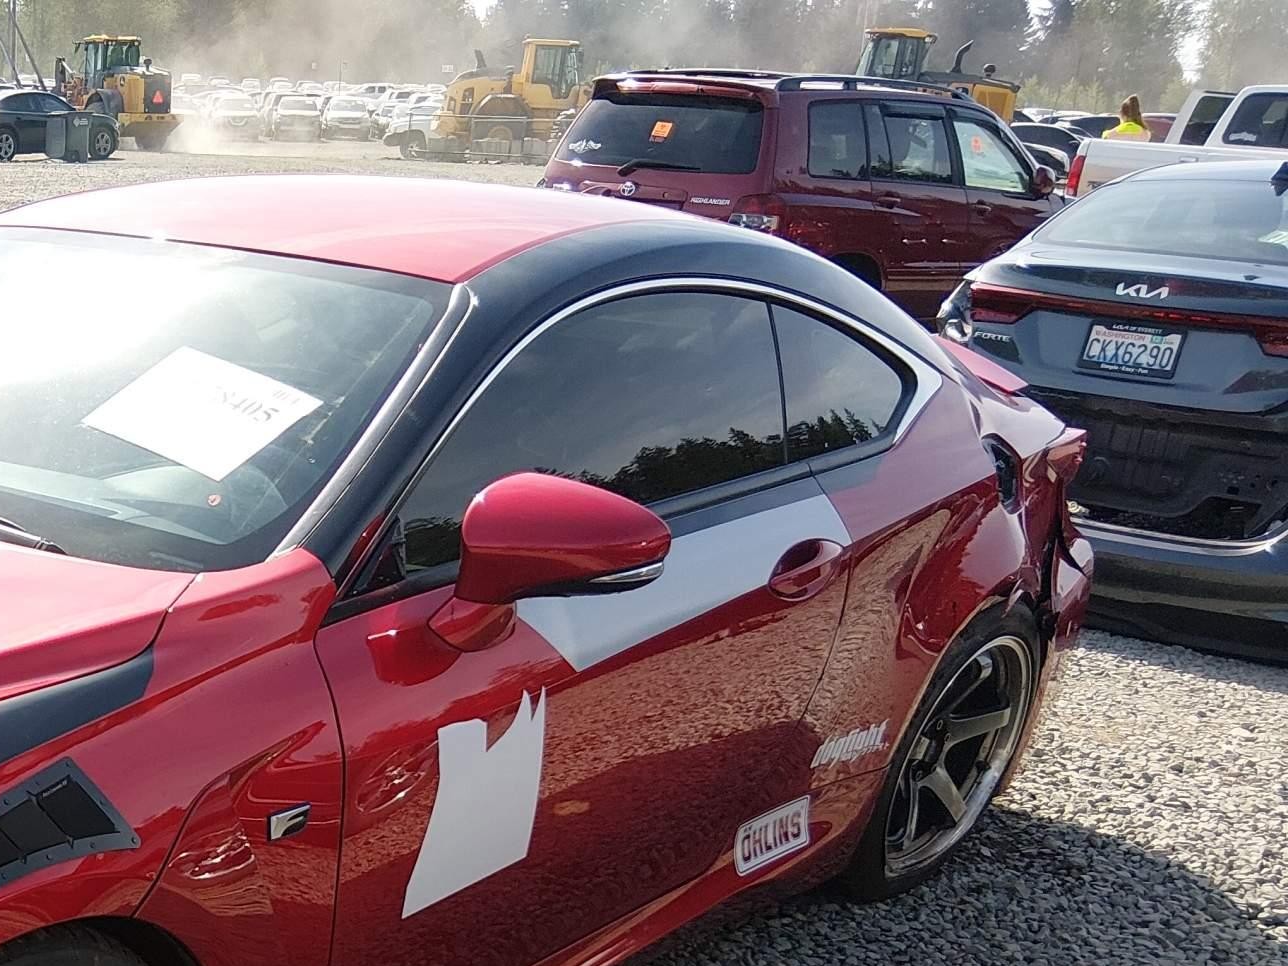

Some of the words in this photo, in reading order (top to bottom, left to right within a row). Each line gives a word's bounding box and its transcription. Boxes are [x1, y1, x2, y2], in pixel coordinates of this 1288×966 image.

[1115, 282, 1170, 300] KIA
[974, 331, 1012, 342] FORTE
[1095, 330, 1147, 342] WASHINGTON
[1086, 337, 1174, 369] CKX6290
[741, 811, 802, 863] ÖHLINS
